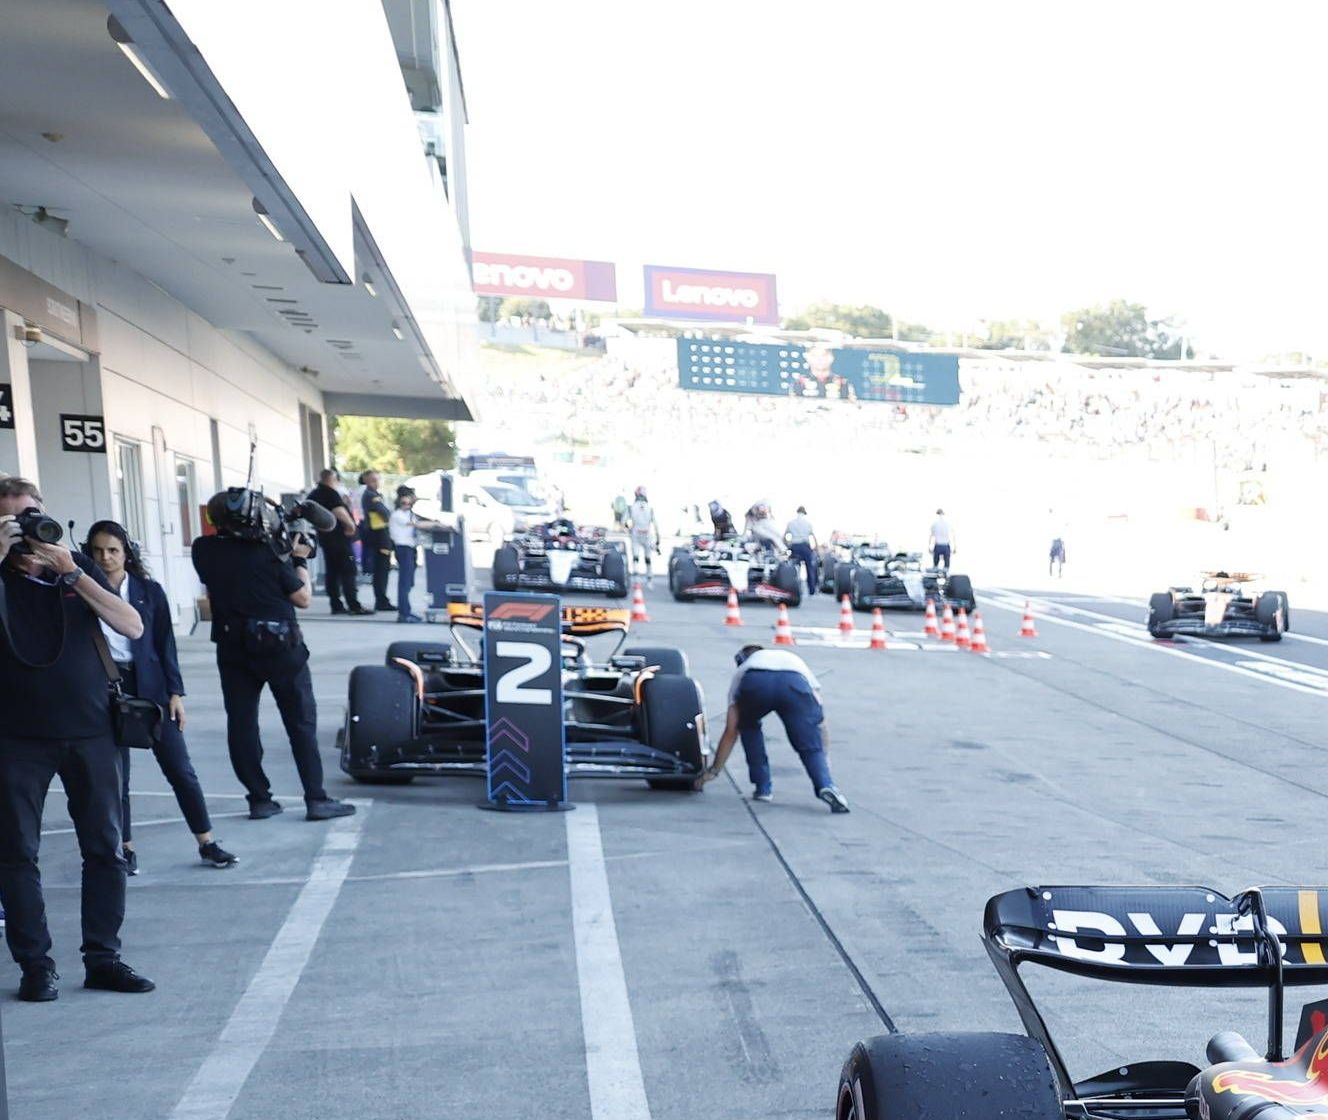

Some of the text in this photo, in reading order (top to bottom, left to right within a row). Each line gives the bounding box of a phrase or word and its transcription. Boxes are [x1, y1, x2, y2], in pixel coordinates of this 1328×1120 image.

[473, 262, 575, 291] enovo
[662, 279, 759, 308] Lenovo
[64, 420, 104, 447] 55
[496, 641, 552, 704] 2
